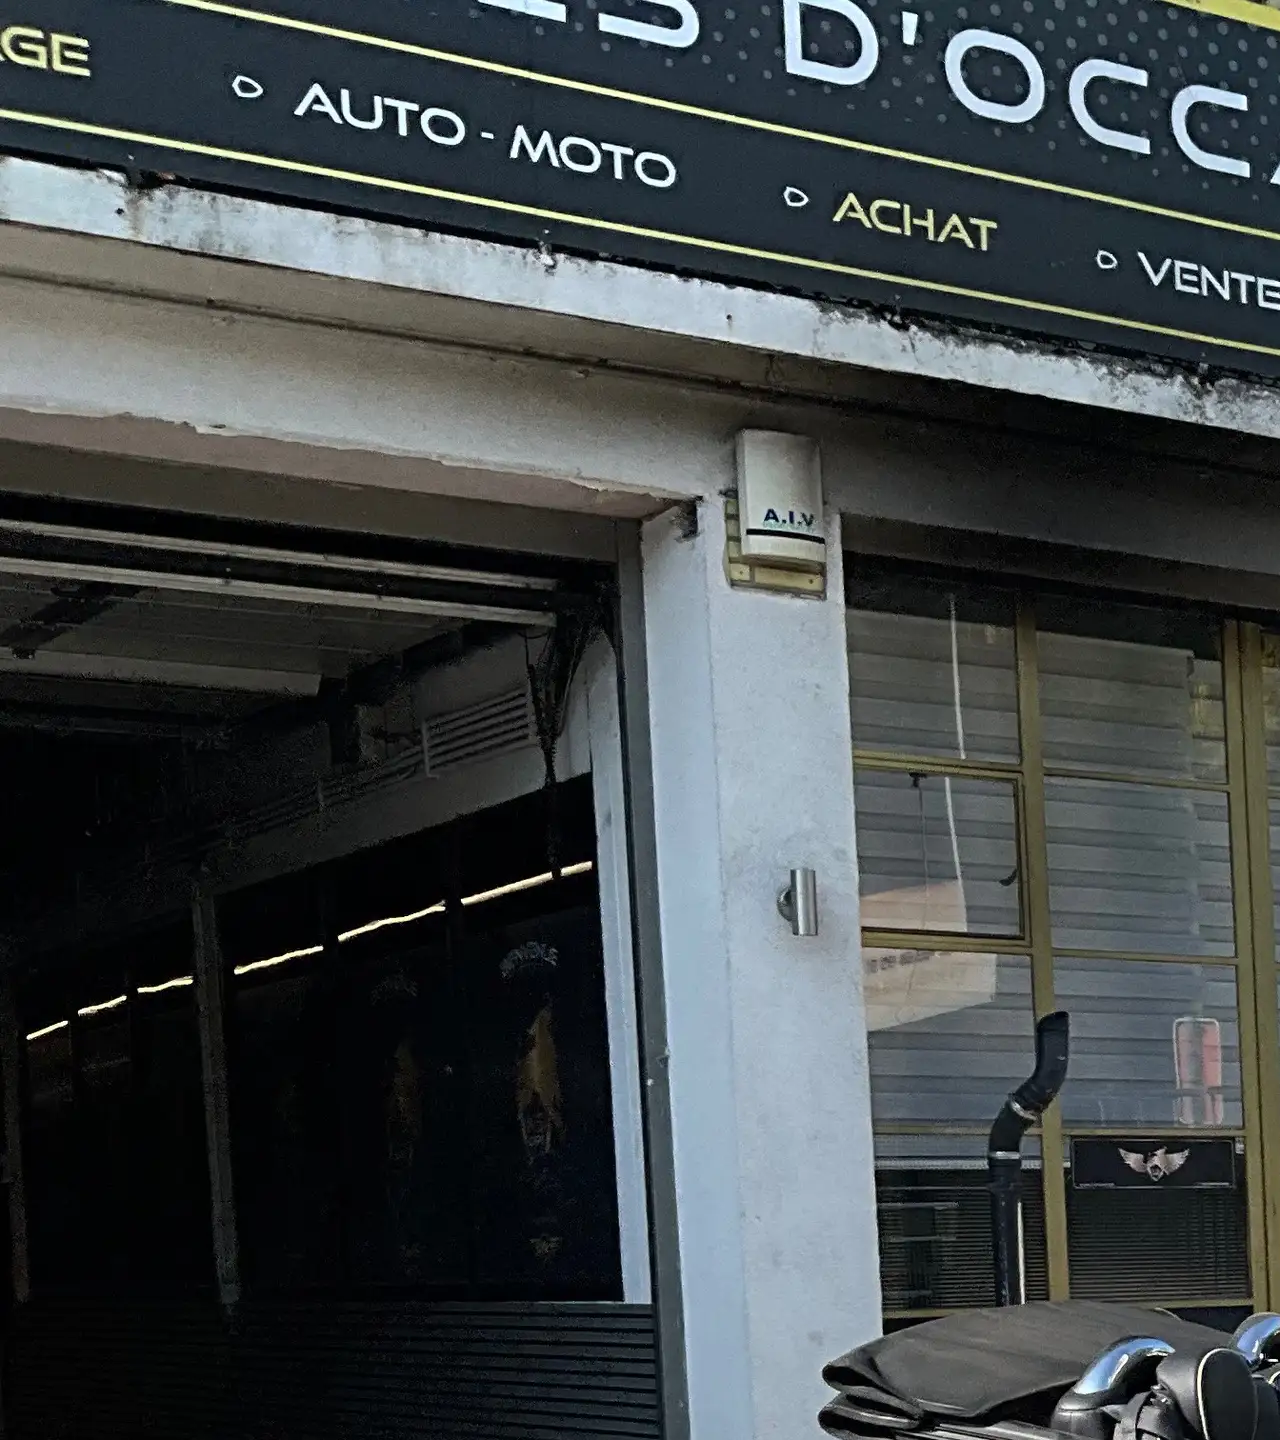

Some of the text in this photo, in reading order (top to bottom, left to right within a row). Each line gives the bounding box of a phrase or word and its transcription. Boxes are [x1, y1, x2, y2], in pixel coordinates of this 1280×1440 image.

[0, 26, 91, 77] GE
[293, 82, 466, 146] AUTO
[509, 124, 677, 188] MOTO
[832, 192, 998, 251] ACHAT
